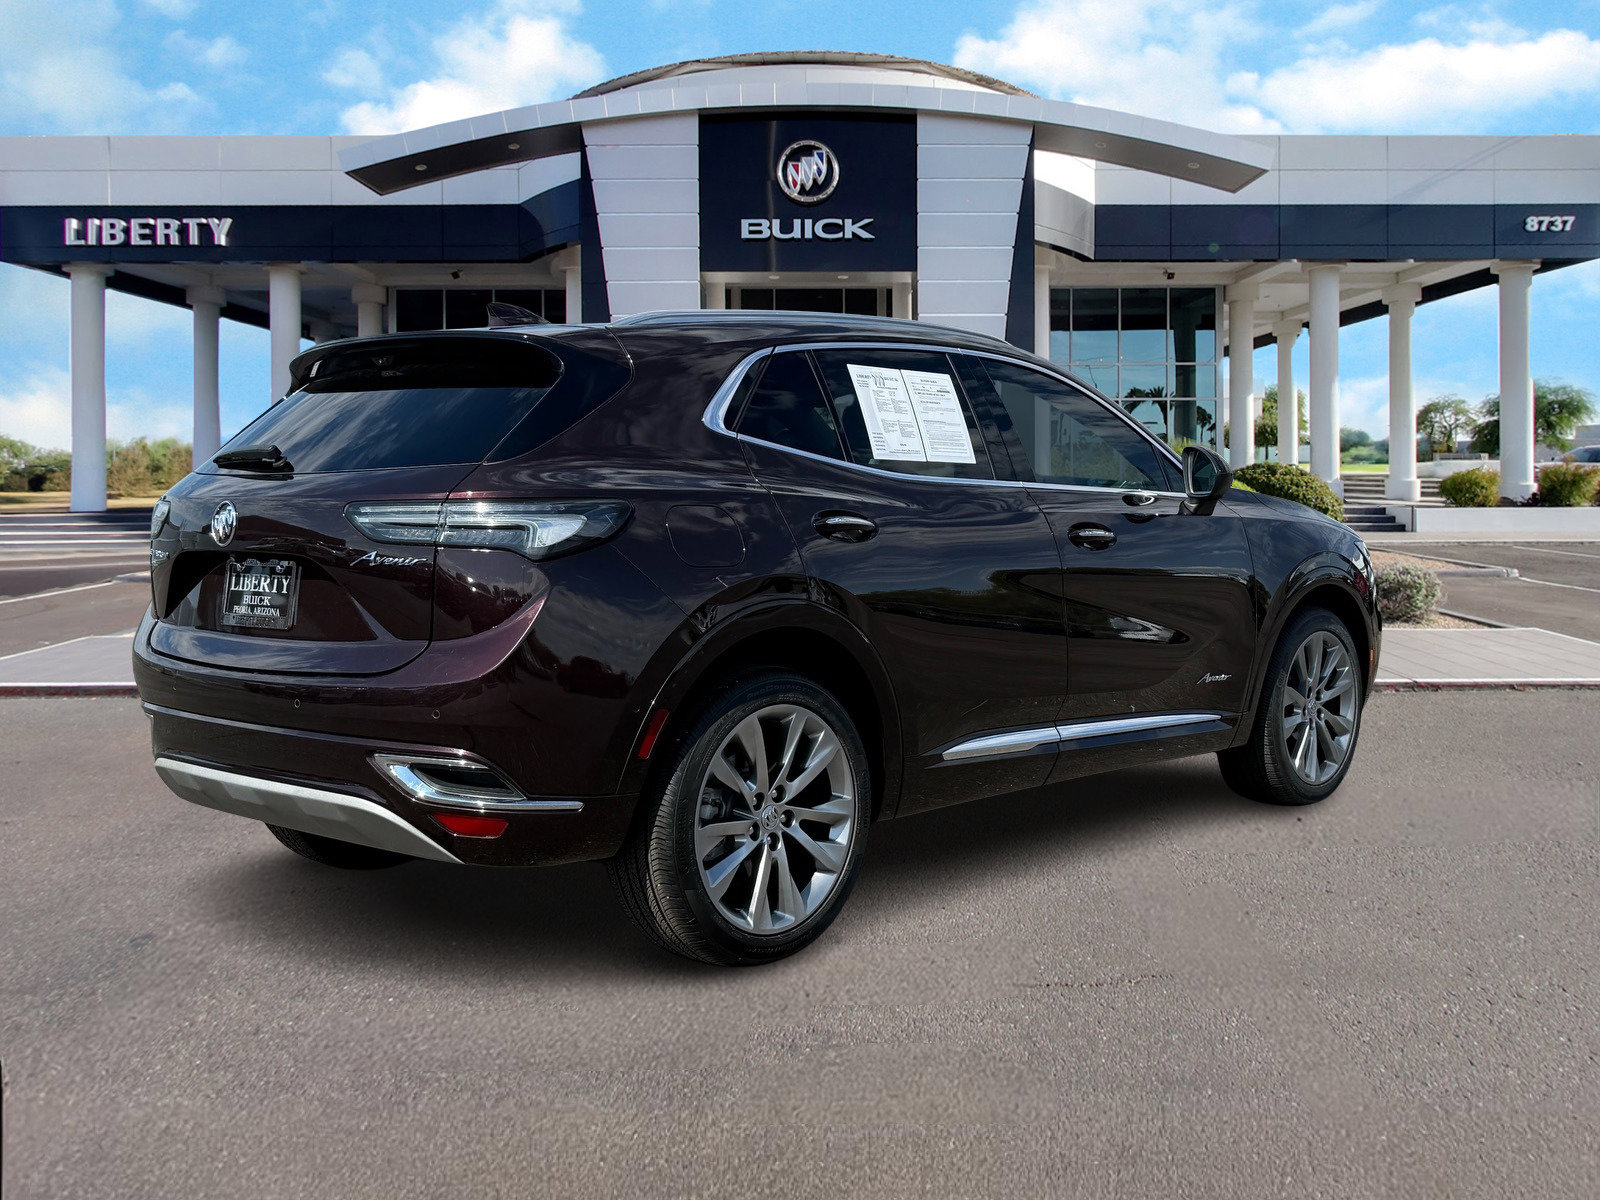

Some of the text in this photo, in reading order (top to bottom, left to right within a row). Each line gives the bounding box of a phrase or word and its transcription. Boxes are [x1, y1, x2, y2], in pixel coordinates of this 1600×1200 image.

[64, 217, 233, 246] LIBERTY
[740, 218, 875, 239] BUICK
[1524, 215, 1576, 232] 8737
[350, 550, 428, 566] Avenir
[230, 572, 291, 594] LIBERTY
[243, 594, 271, 606] BUICK
[233, 605, 280, 617] PEORIA, ARIZONA
